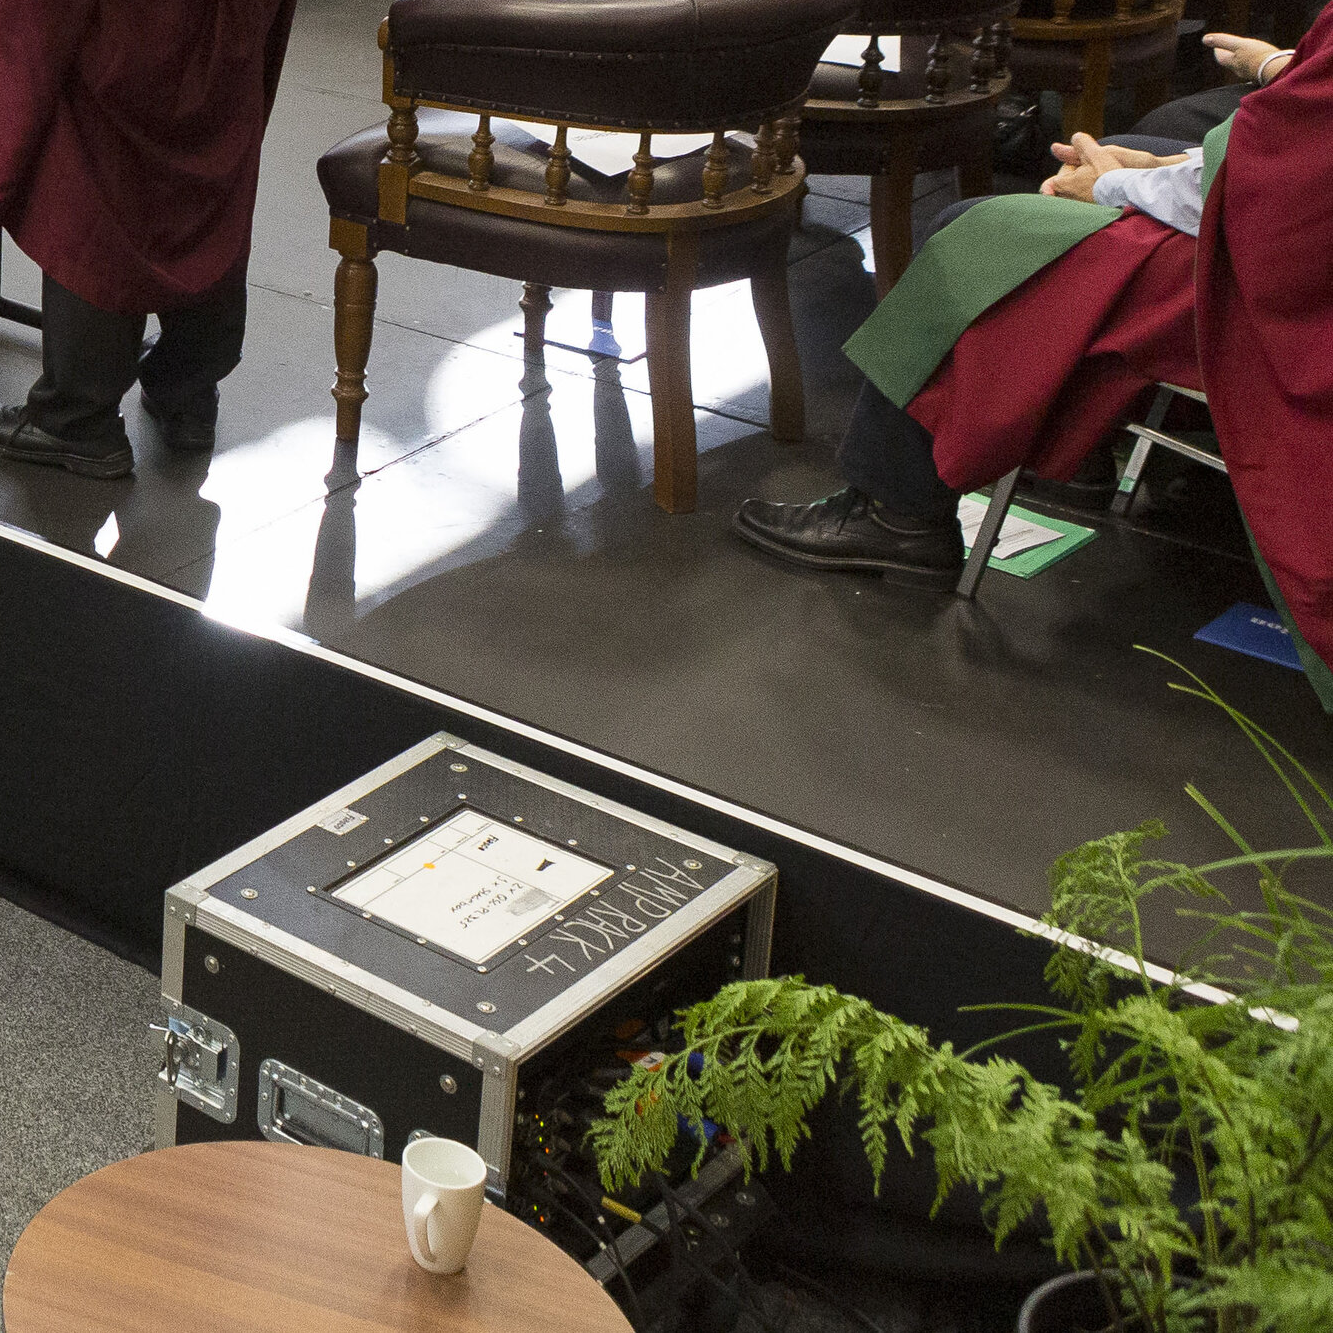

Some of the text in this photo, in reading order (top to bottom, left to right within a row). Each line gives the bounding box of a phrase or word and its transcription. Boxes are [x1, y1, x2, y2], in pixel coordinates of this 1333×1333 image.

[523, 856, 705, 975] AMP RACK 4
